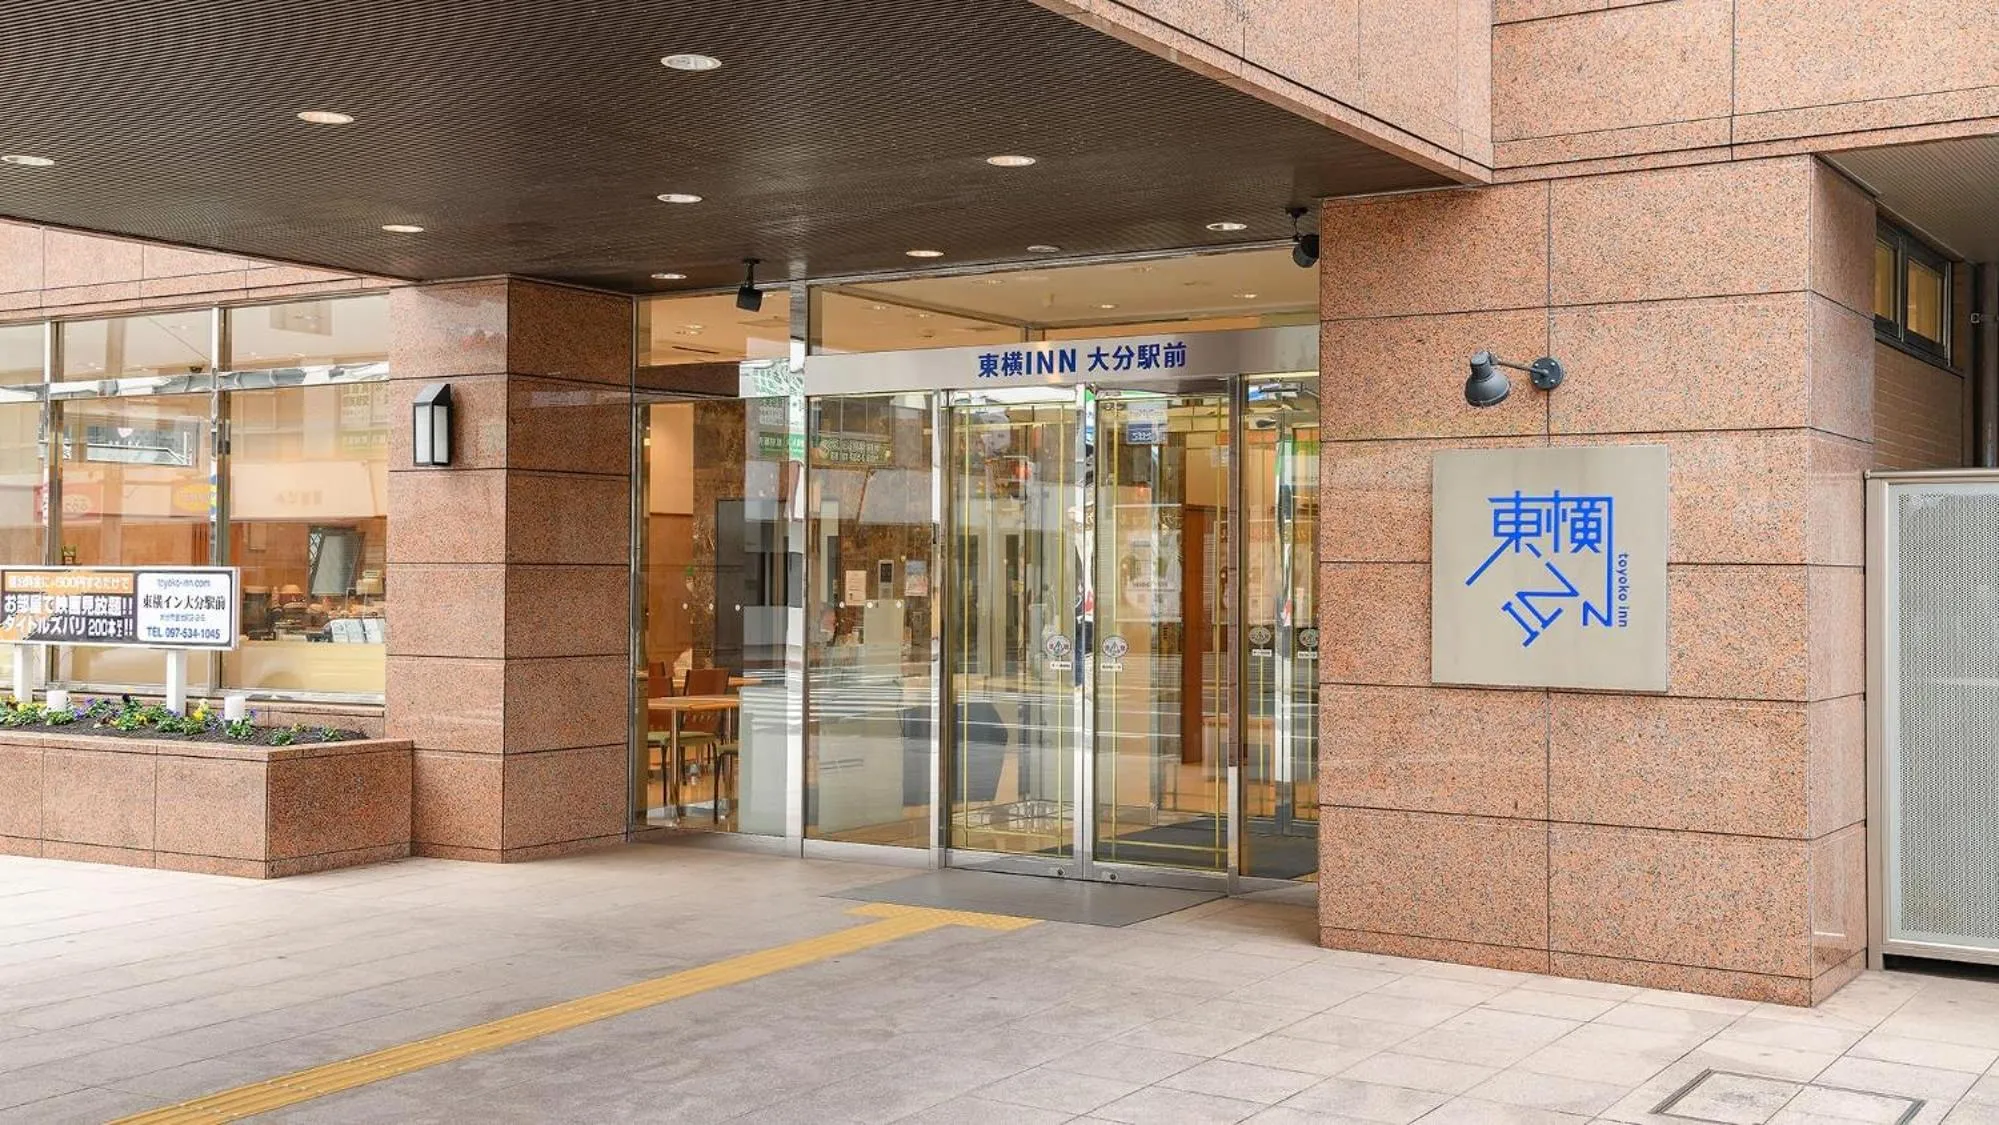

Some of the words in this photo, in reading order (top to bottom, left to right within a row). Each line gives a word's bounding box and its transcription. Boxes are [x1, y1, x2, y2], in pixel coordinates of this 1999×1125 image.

[978, 348, 1077, 378] 東横INN
[1087, 341, 1187, 372] 大分駅前
[1615, 553, 1632, 601] toyoko
[143, 594, 226, 610] 東横イン大分駅前
[1617, 606, 1631, 628] inn
[147, 627, 163, 637] TEL
[165, 627, 221, 639] 097-534-1045
